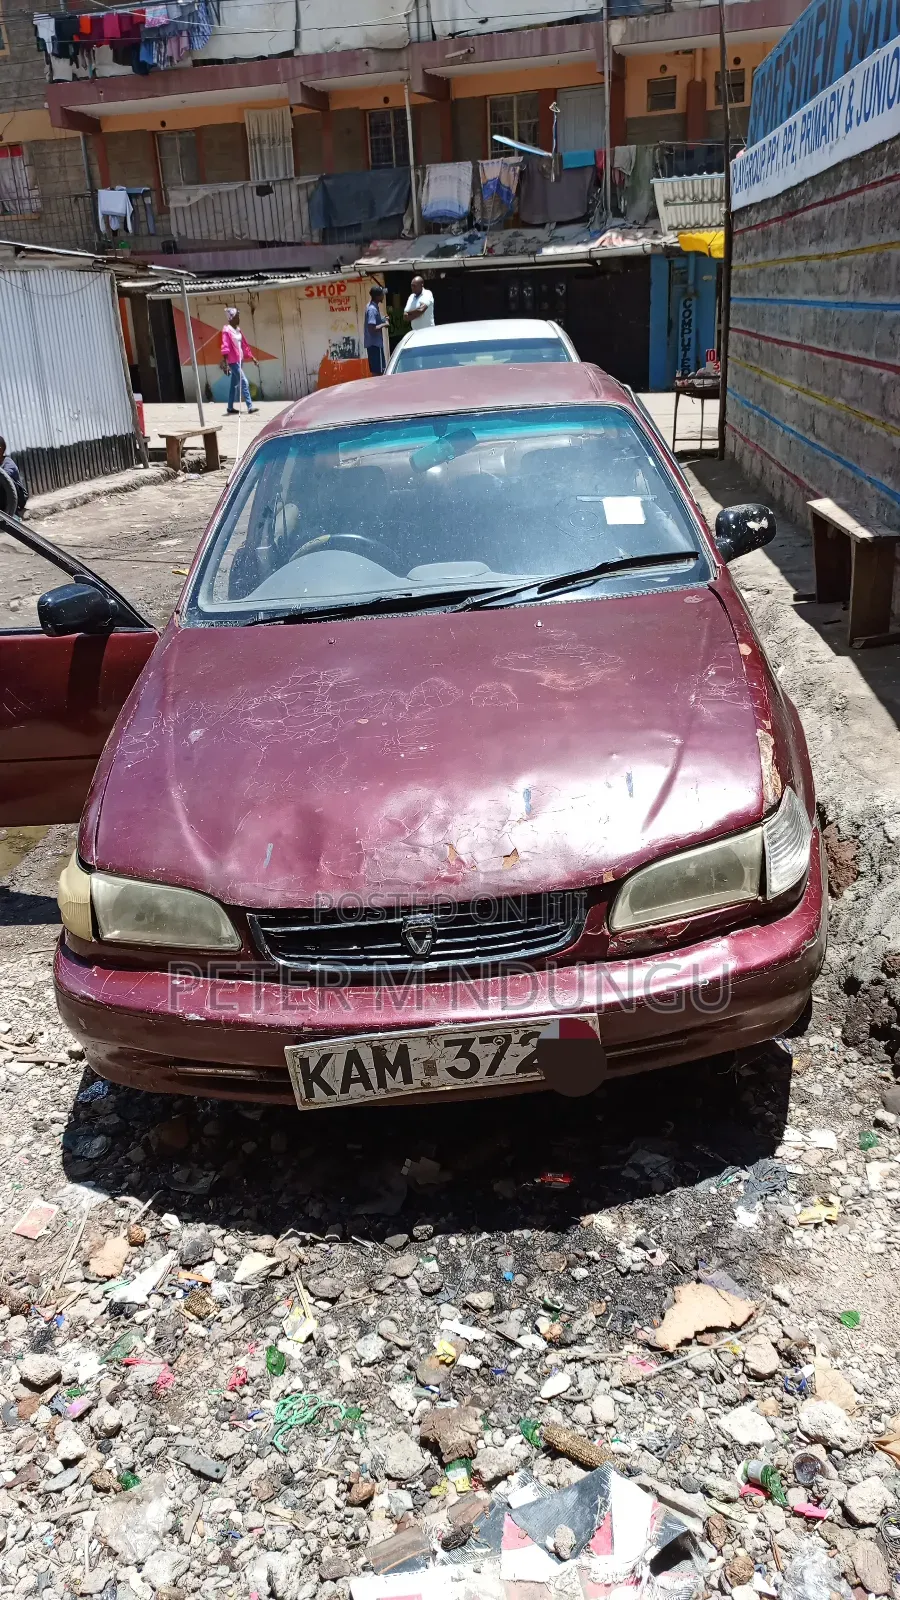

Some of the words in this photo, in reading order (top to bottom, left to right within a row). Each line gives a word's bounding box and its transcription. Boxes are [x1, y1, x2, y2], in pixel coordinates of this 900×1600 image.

[749, 0, 842, 146] SPORTSVIEW
[799, 86, 845, 160] PRIMARY
[845, 79, 855, 134] &
[856, 46, 900, 127] JUNIO
[305, 283, 347, 298] SHOP
[300, 1046, 414, 1100] KAM
